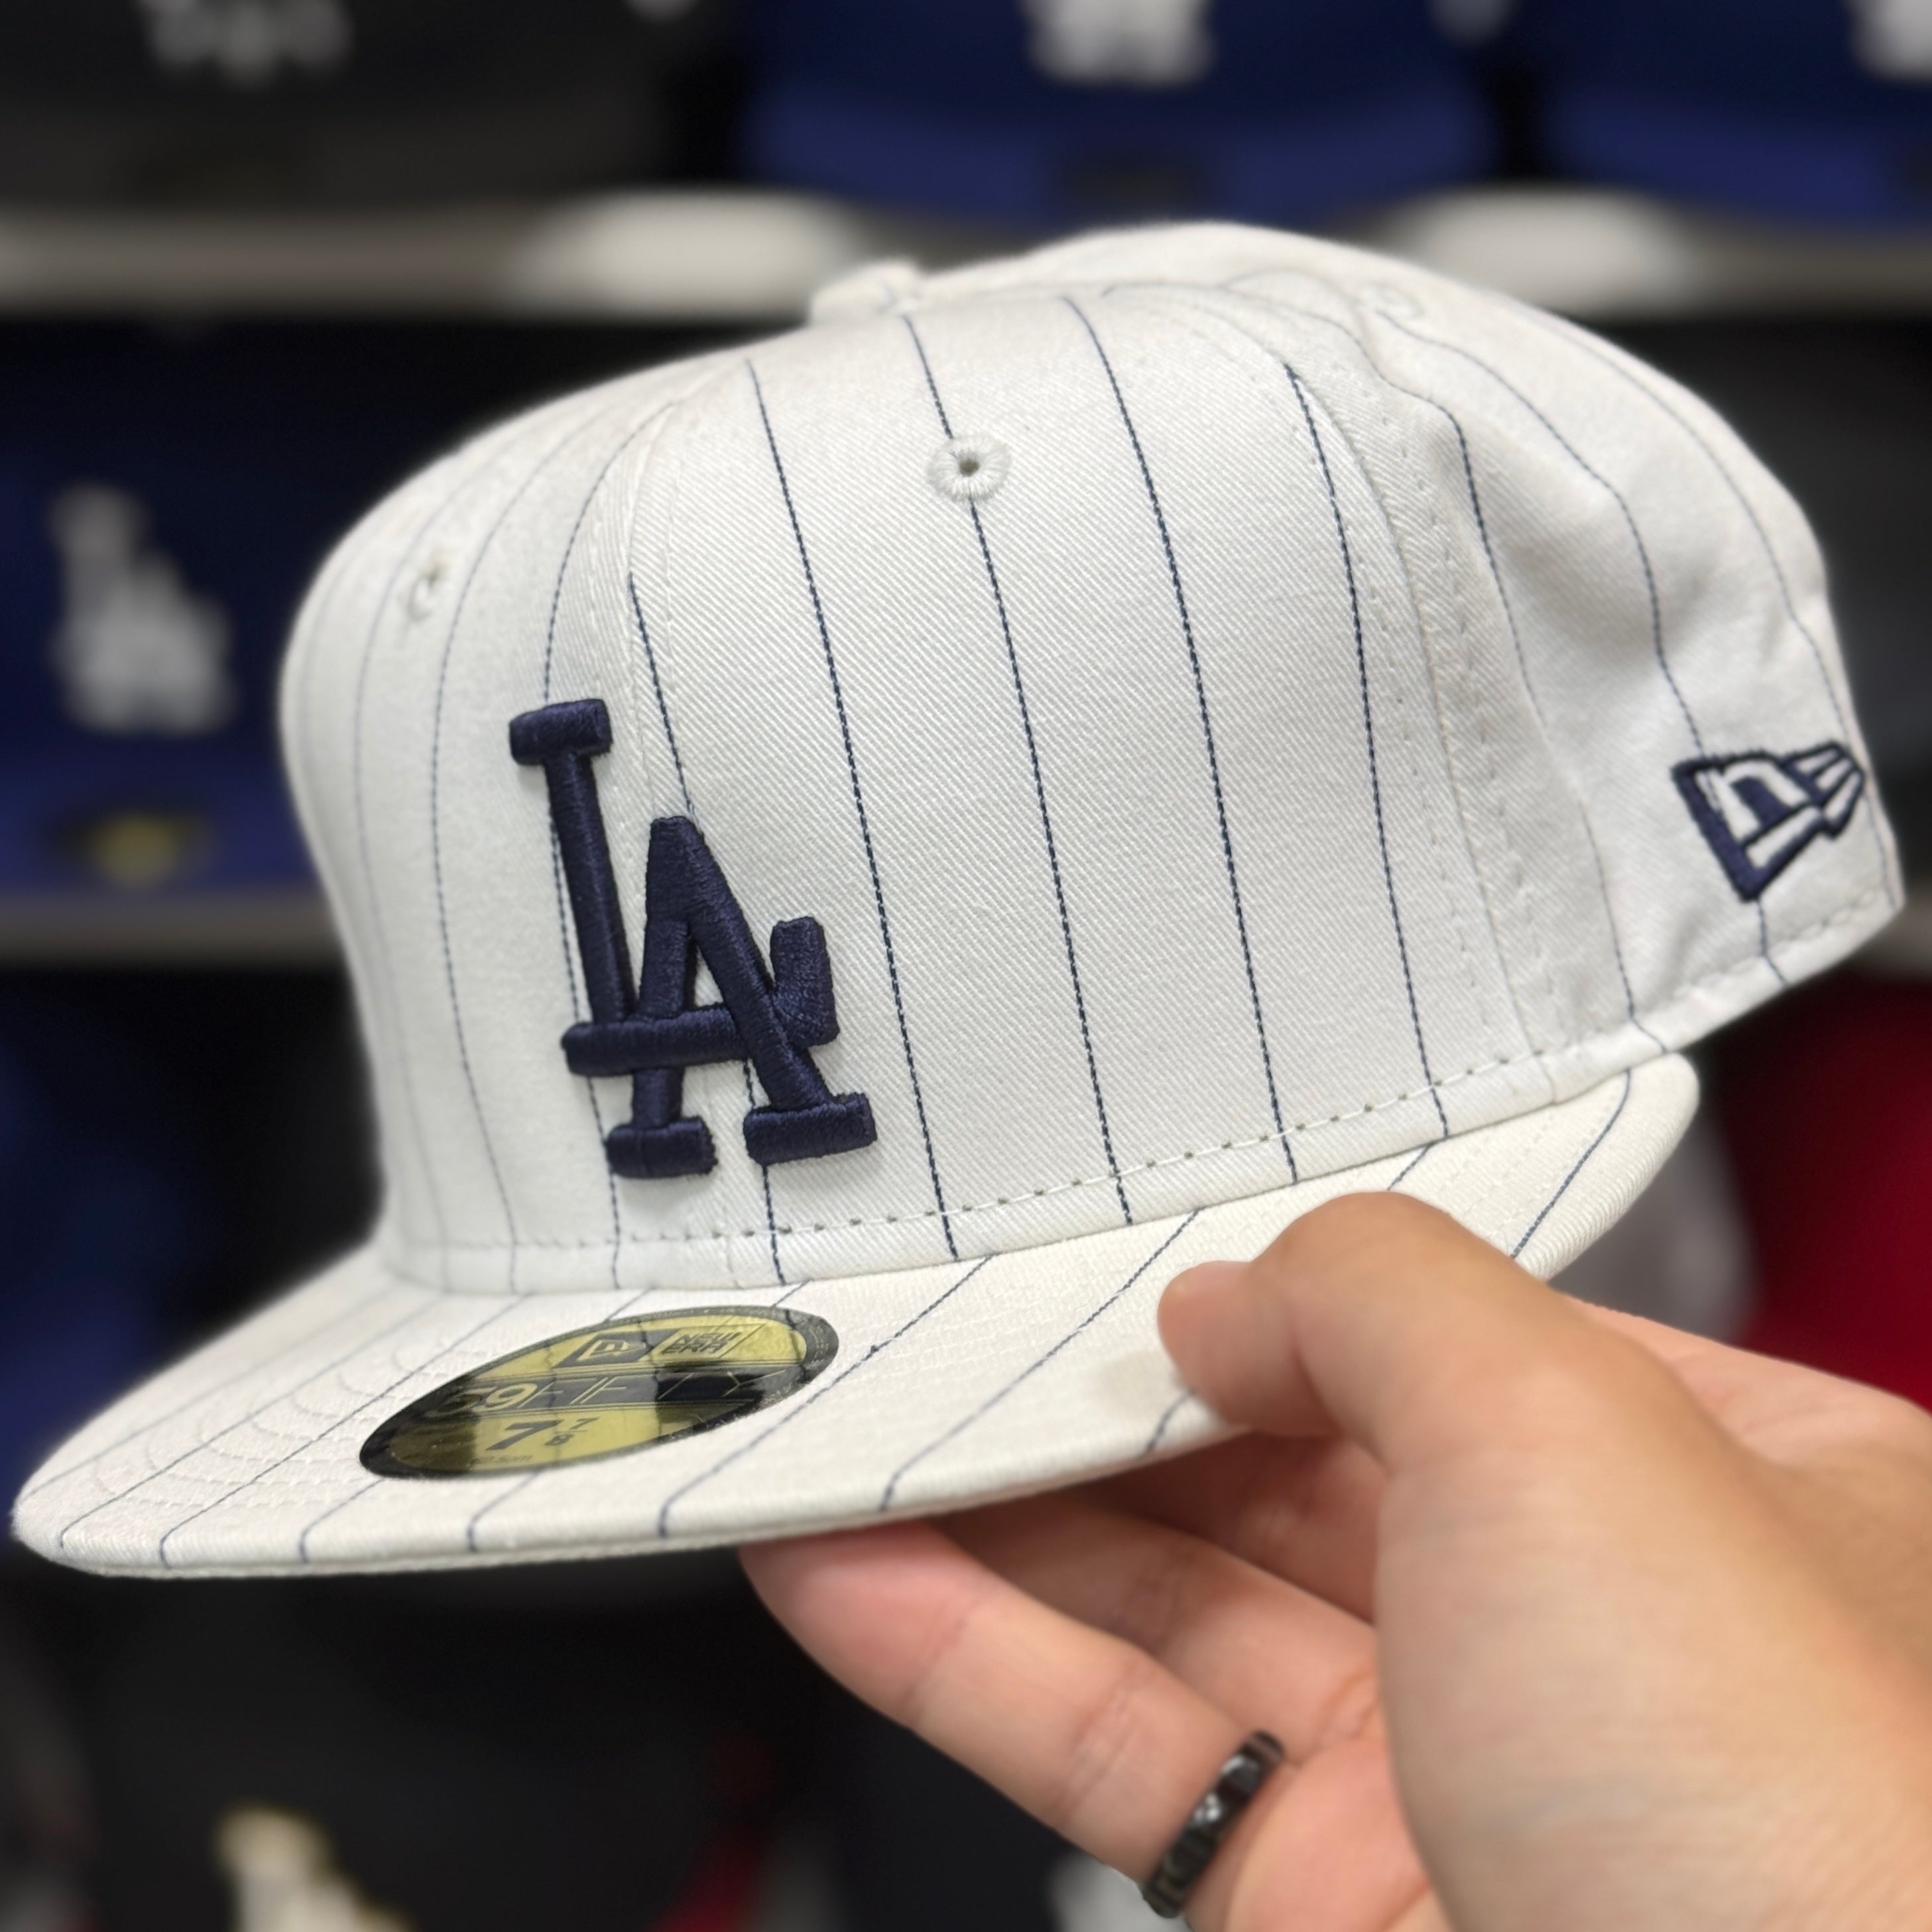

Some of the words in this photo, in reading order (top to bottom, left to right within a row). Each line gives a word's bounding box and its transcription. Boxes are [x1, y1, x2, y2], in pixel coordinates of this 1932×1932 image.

[509, 698, 877, 1179] LA
[660, 1339, 729, 1354] ERA
[675, 1331, 742, 1344] NEW
[485, 1419, 564, 1451] 7
